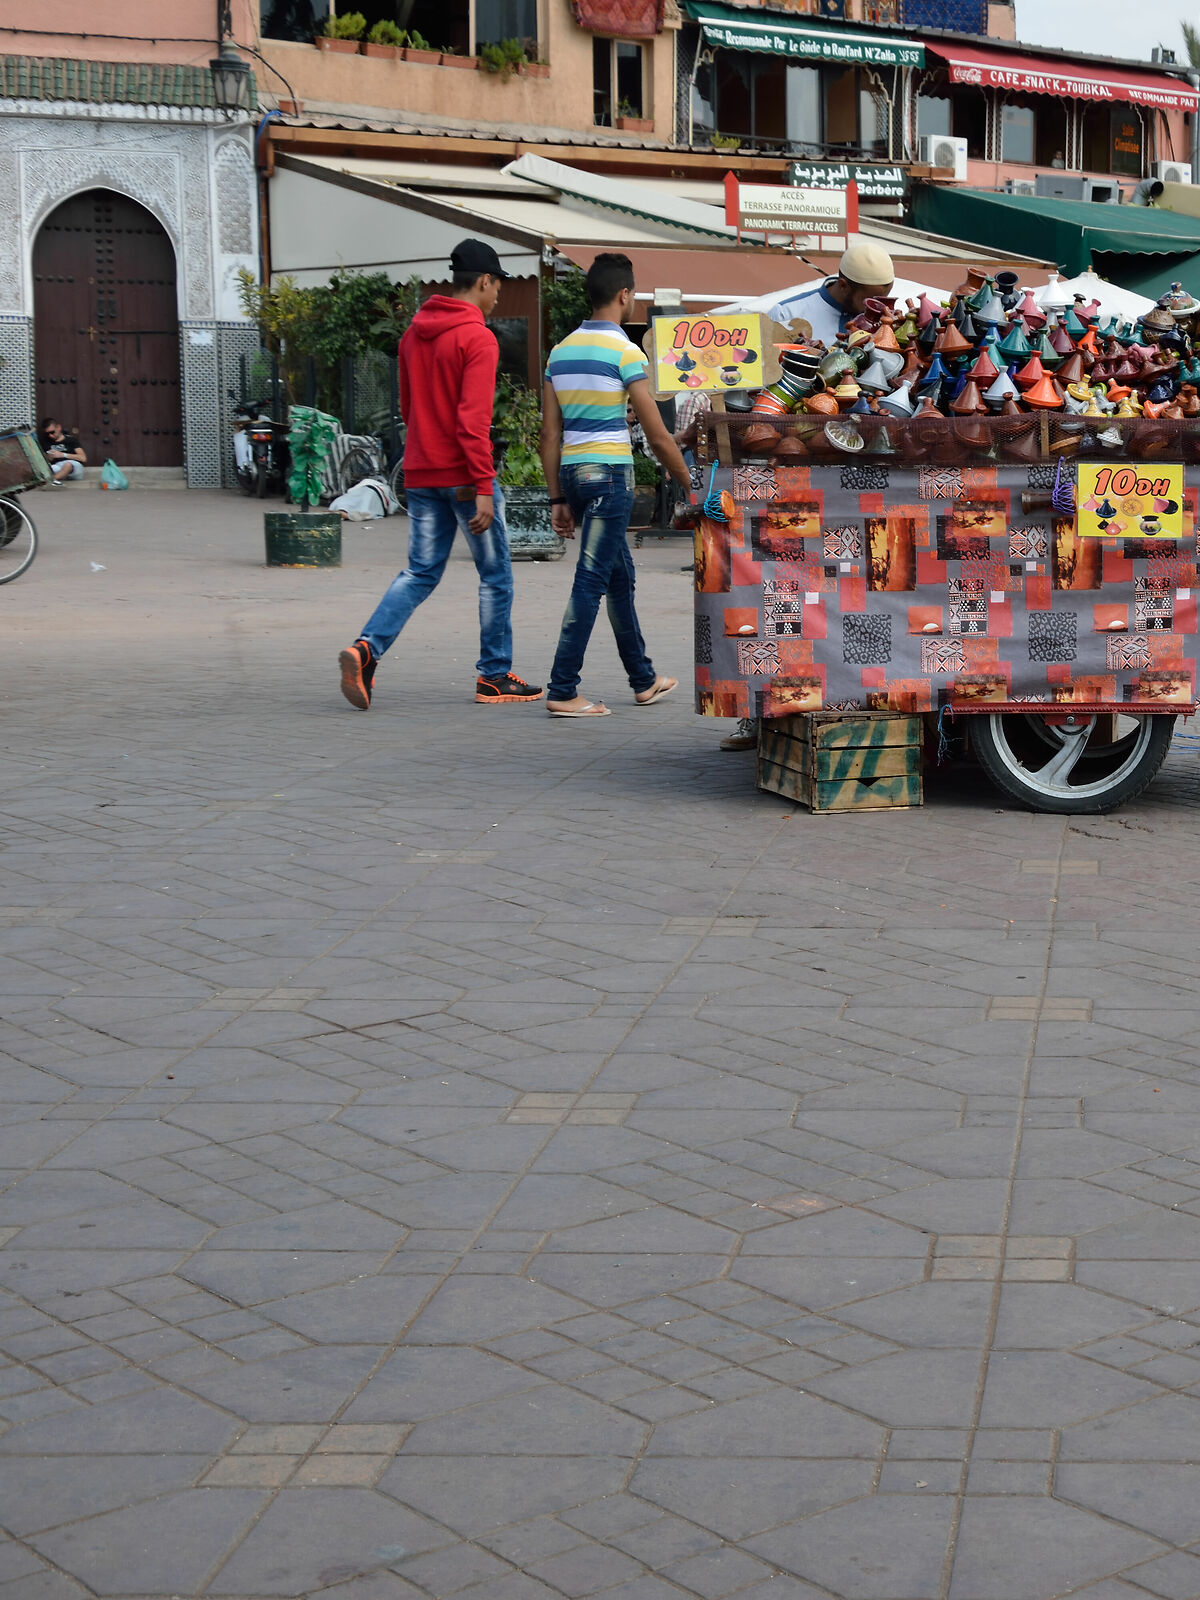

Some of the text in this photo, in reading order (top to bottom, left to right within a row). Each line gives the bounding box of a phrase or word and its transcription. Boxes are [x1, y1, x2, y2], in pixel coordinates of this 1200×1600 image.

[990, 70, 1020, 86] CAFE
[1180, 97, 1194, 107] PAR
[744, 201, 841, 215] TERRASSE PANORAMIQUE
[744, 218, 838, 233] PANORAMIC TERRACE ACCESS
